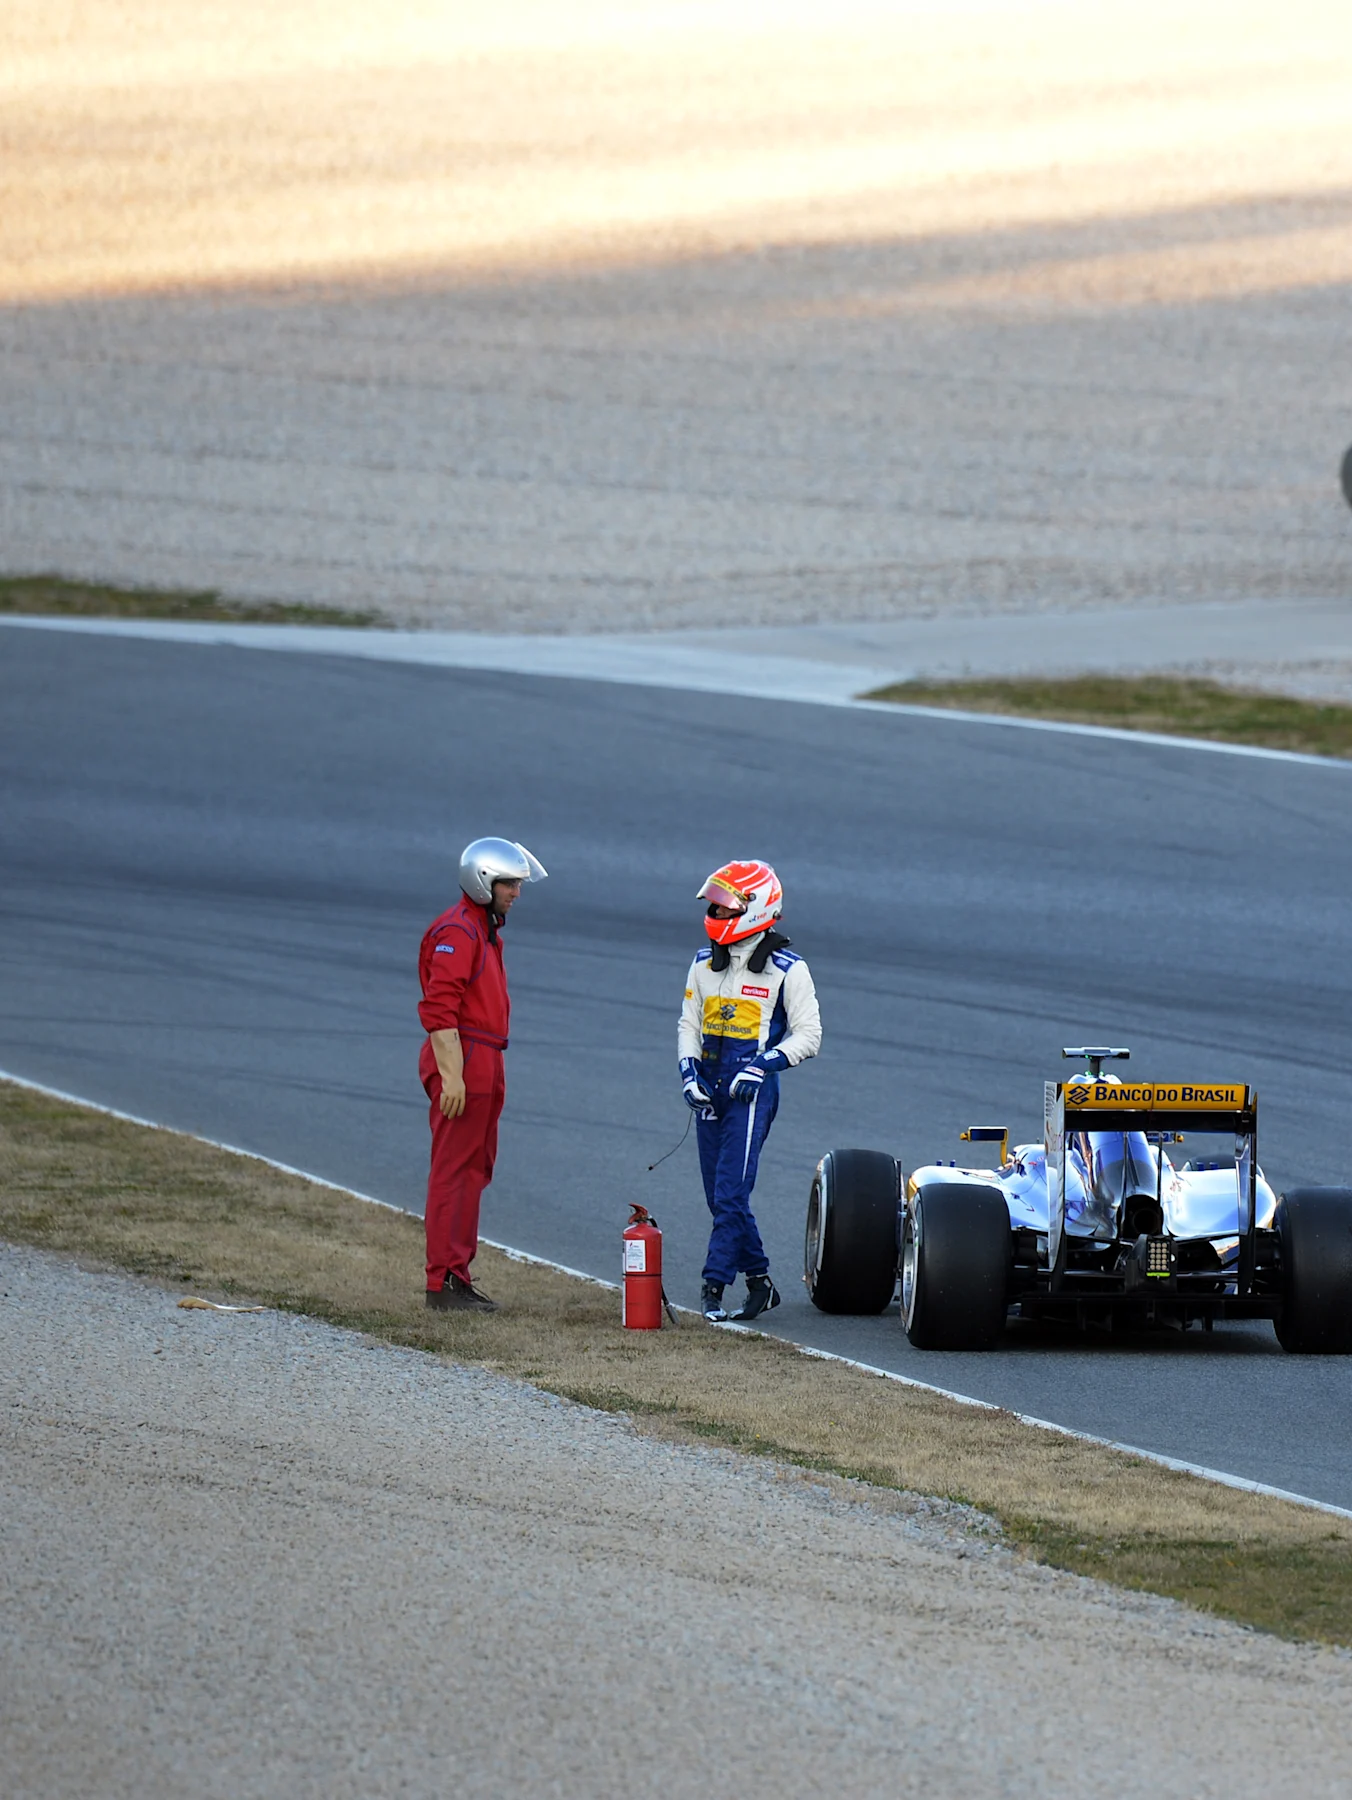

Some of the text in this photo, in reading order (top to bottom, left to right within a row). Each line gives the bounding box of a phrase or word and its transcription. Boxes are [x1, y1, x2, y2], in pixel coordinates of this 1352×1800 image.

[1095, 1086, 1238, 1103] BANCO DO BRASIL
